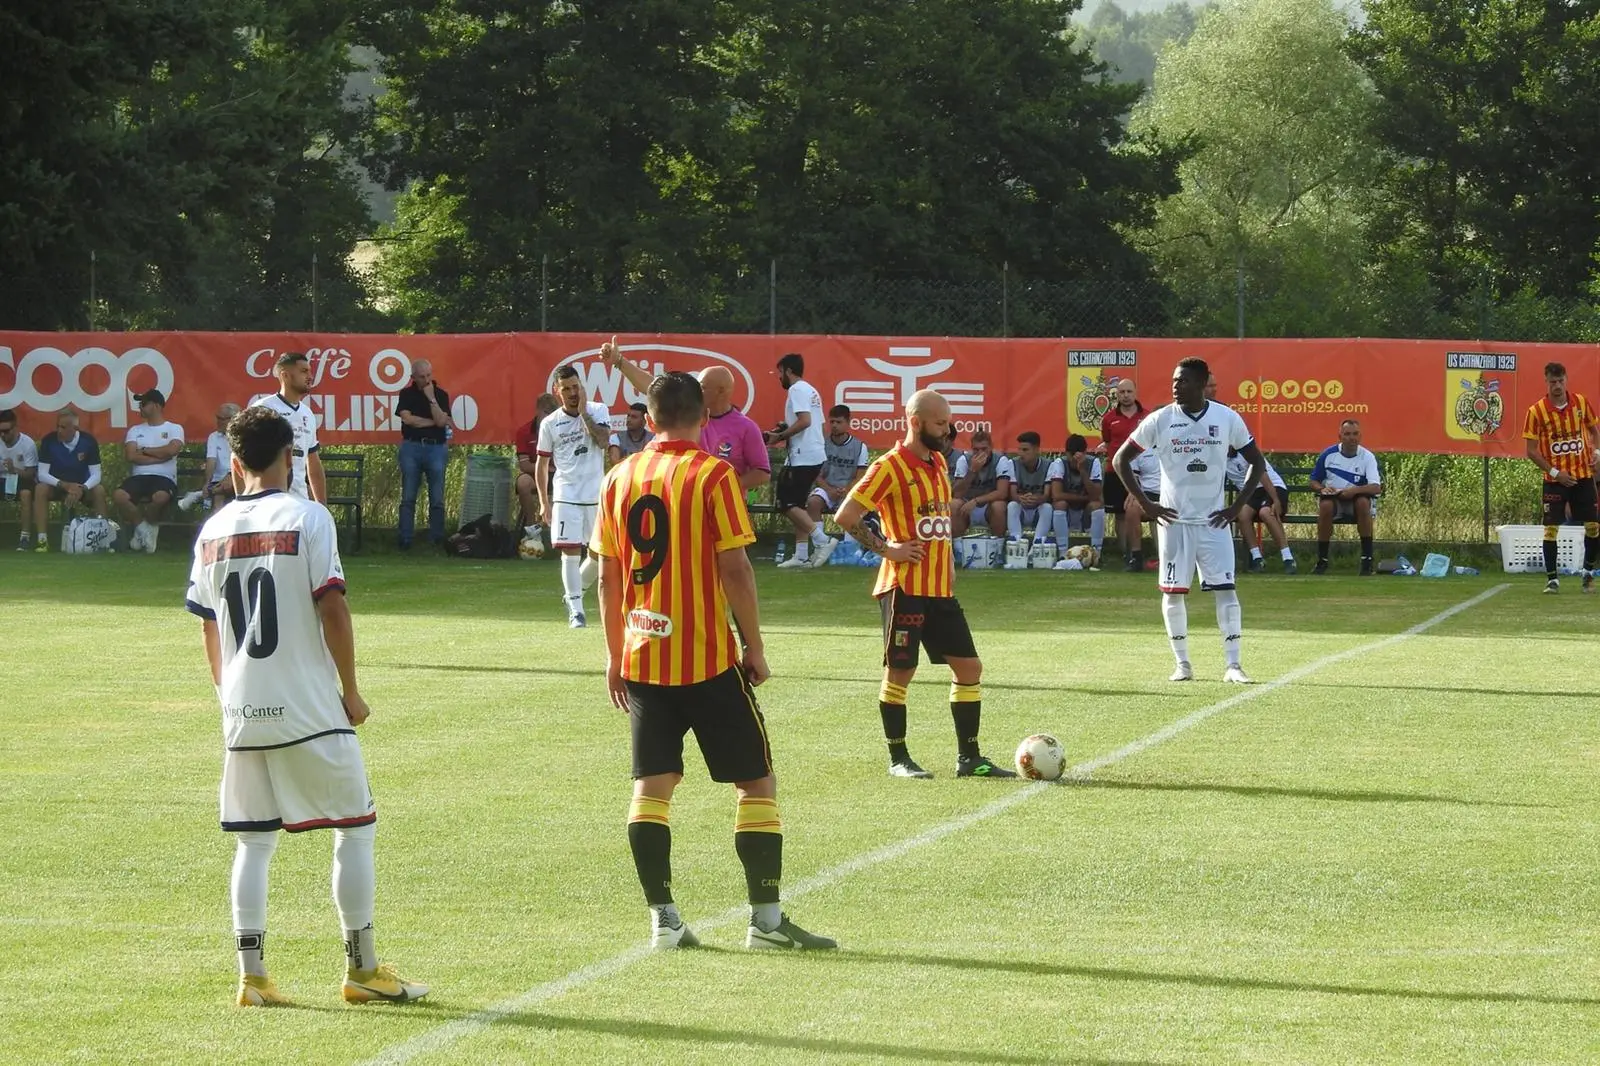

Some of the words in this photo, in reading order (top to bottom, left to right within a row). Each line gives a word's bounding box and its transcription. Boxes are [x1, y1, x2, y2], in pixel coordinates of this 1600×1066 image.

[245, 348, 351, 388] Cfè
[1118, 351, 1135, 365] 1929
[1498, 355, 1515, 370] 1929
[1551, 440, 1583, 455] coop
[627, 494, 670, 585] 9
[1167, 562, 1176, 581] 21
[220, 567, 279, 659] 10
[631, 612, 669, 633] Wüber
